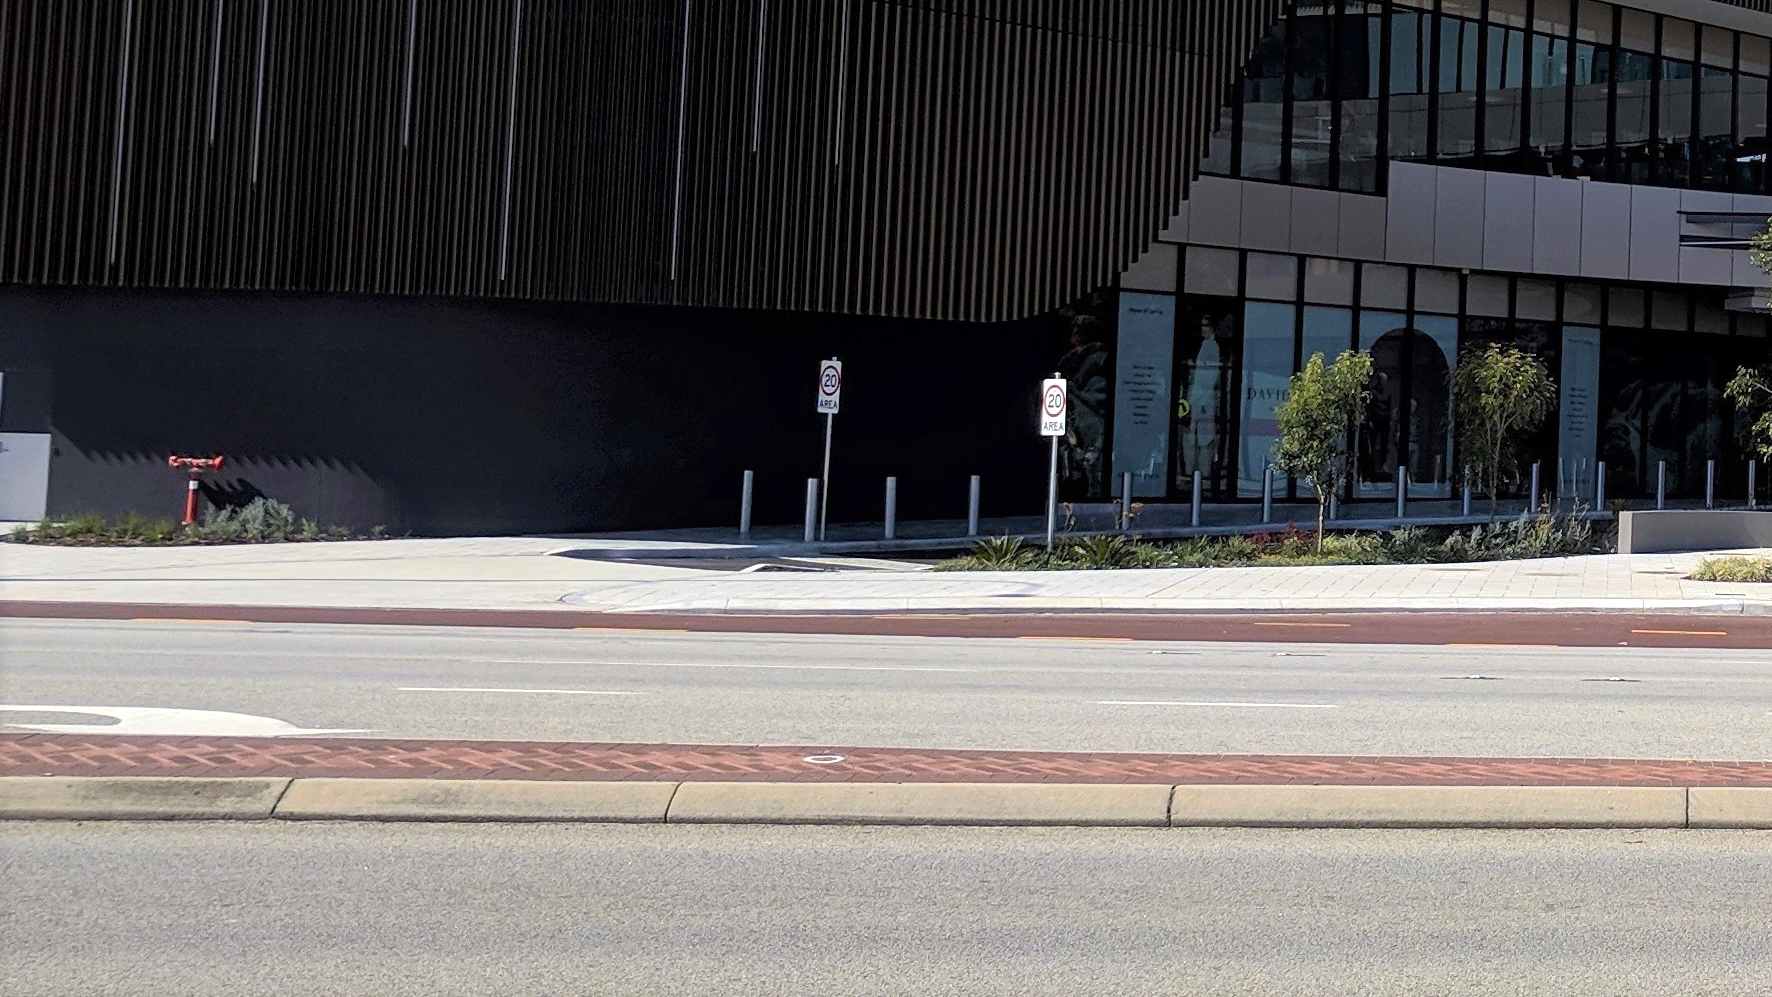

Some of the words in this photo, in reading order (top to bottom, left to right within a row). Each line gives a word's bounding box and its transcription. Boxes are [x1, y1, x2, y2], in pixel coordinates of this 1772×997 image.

[824, 373, 837, 388] 20
[819, 399, 838, 409] AREA
[1048, 393, 1062, 408] 20
[1043, 422, 1064, 431] AREA
